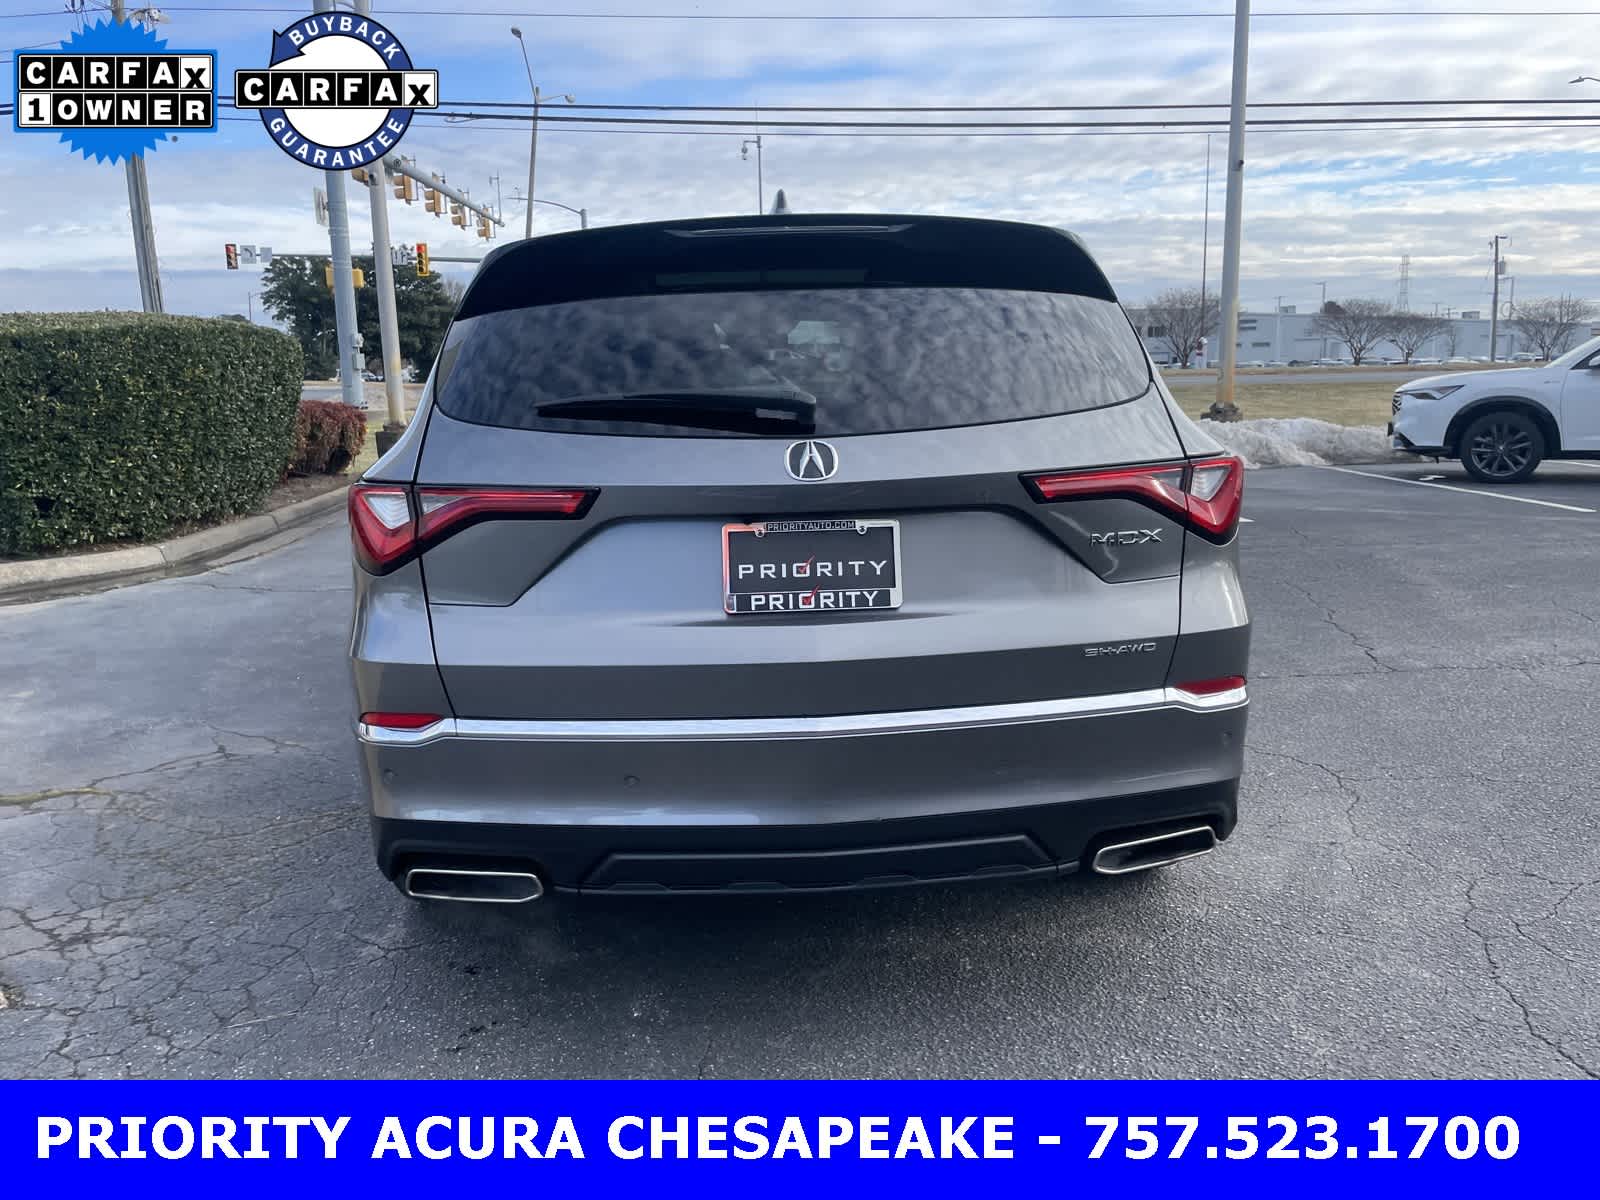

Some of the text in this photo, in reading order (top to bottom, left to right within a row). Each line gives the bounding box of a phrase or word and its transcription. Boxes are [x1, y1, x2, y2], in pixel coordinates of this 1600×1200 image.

[767, 520, 856, 532] PRIORITYAUTO.COM
[1090, 528, 1163, 548] MDX
[738, 560, 888, 579] PRIORITY
[751, 590, 879, 611] PRIORITY
[1084, 642, 1157, 657] SH-AWD
